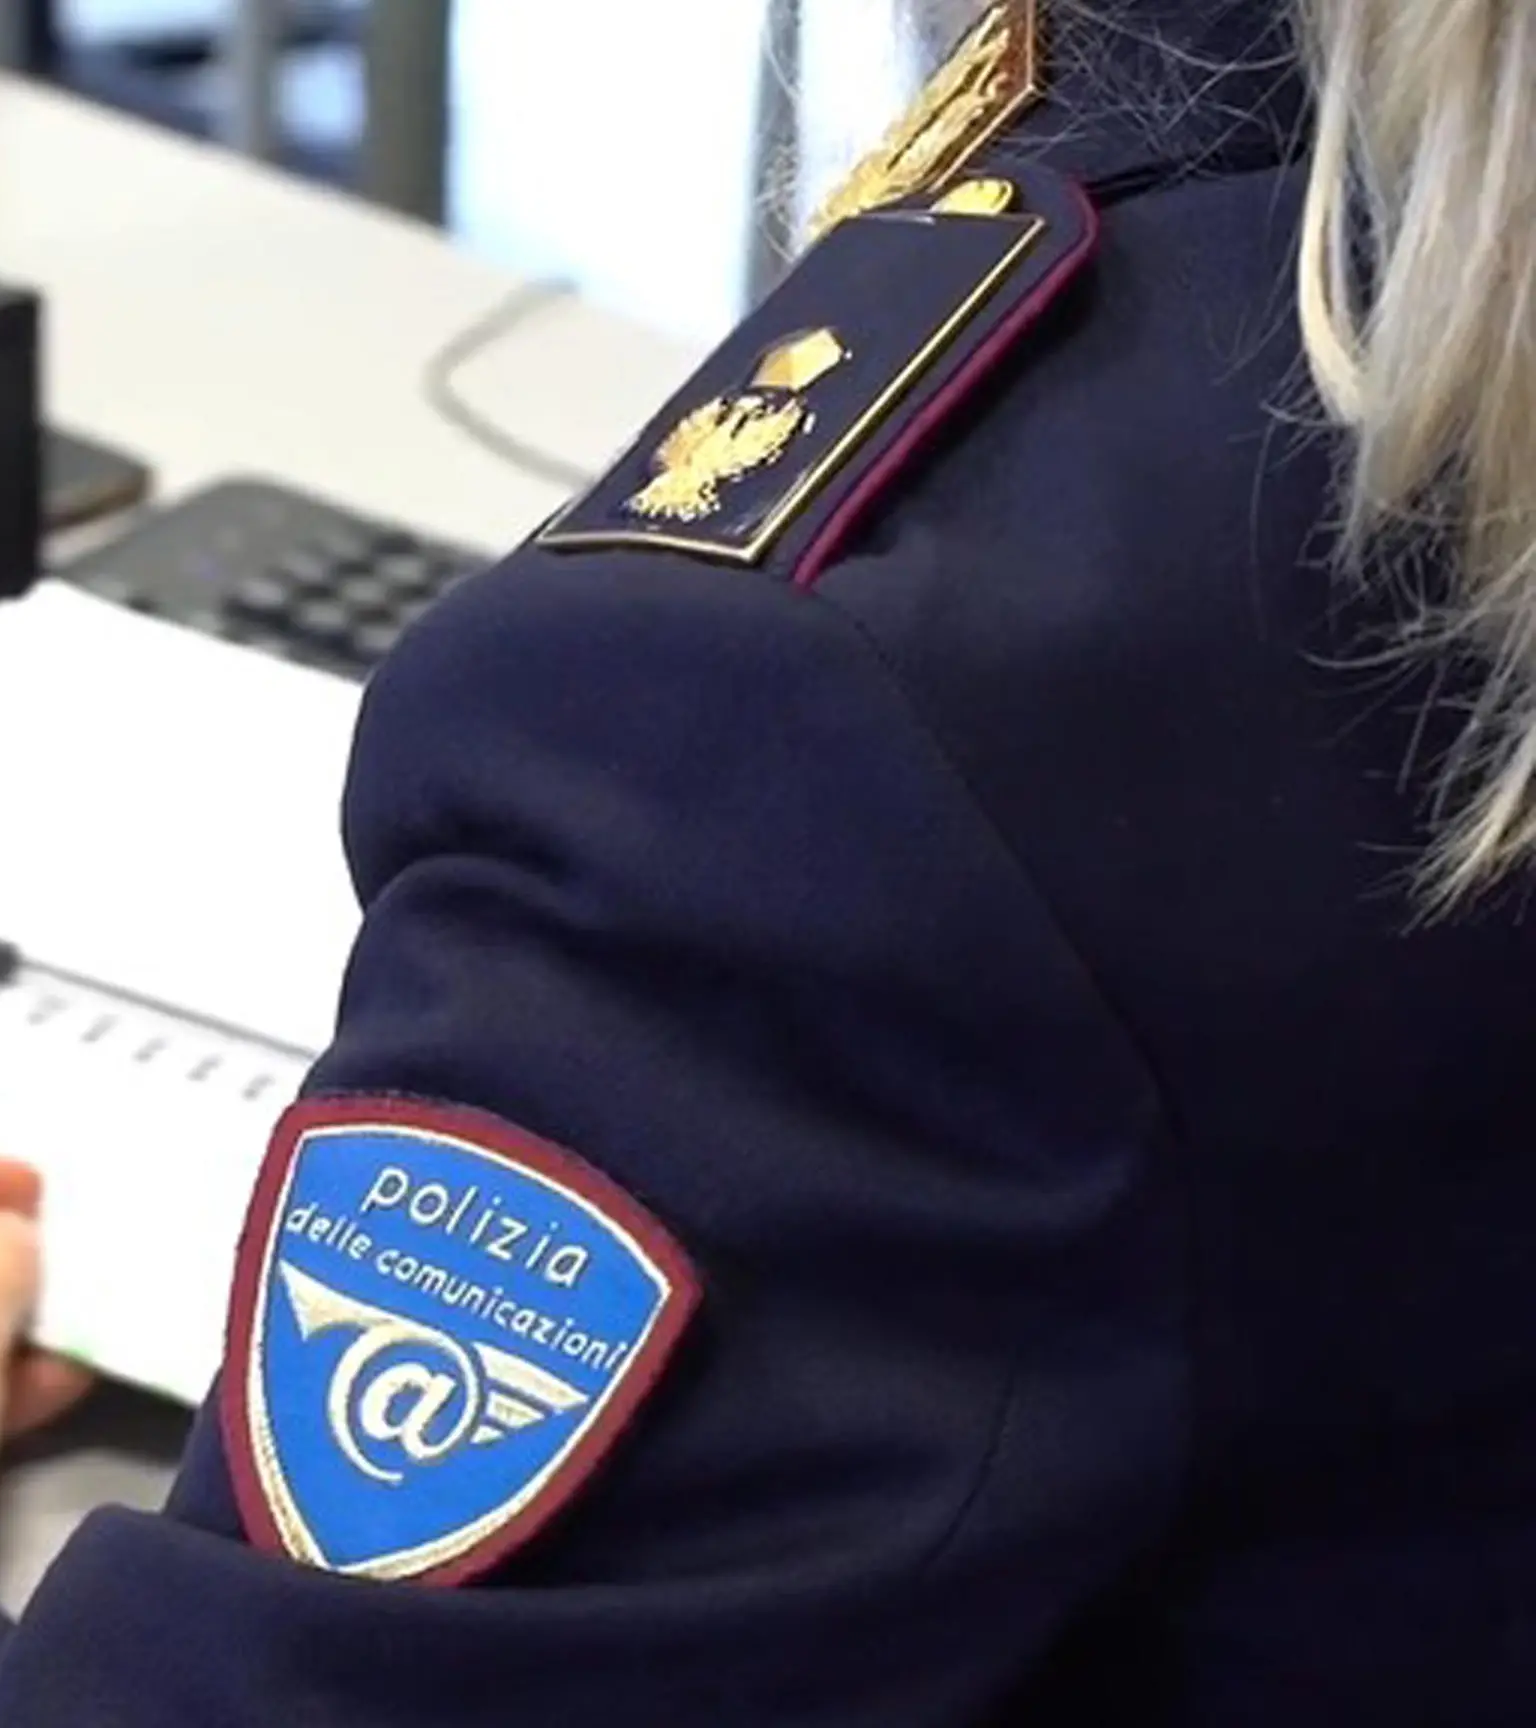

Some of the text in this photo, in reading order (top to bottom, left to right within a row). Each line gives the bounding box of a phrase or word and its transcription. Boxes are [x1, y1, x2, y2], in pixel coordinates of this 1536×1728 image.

[285, 1202, 629, 1370] delle comunicazioni
[361, 1167, 589, 1288] polizia
